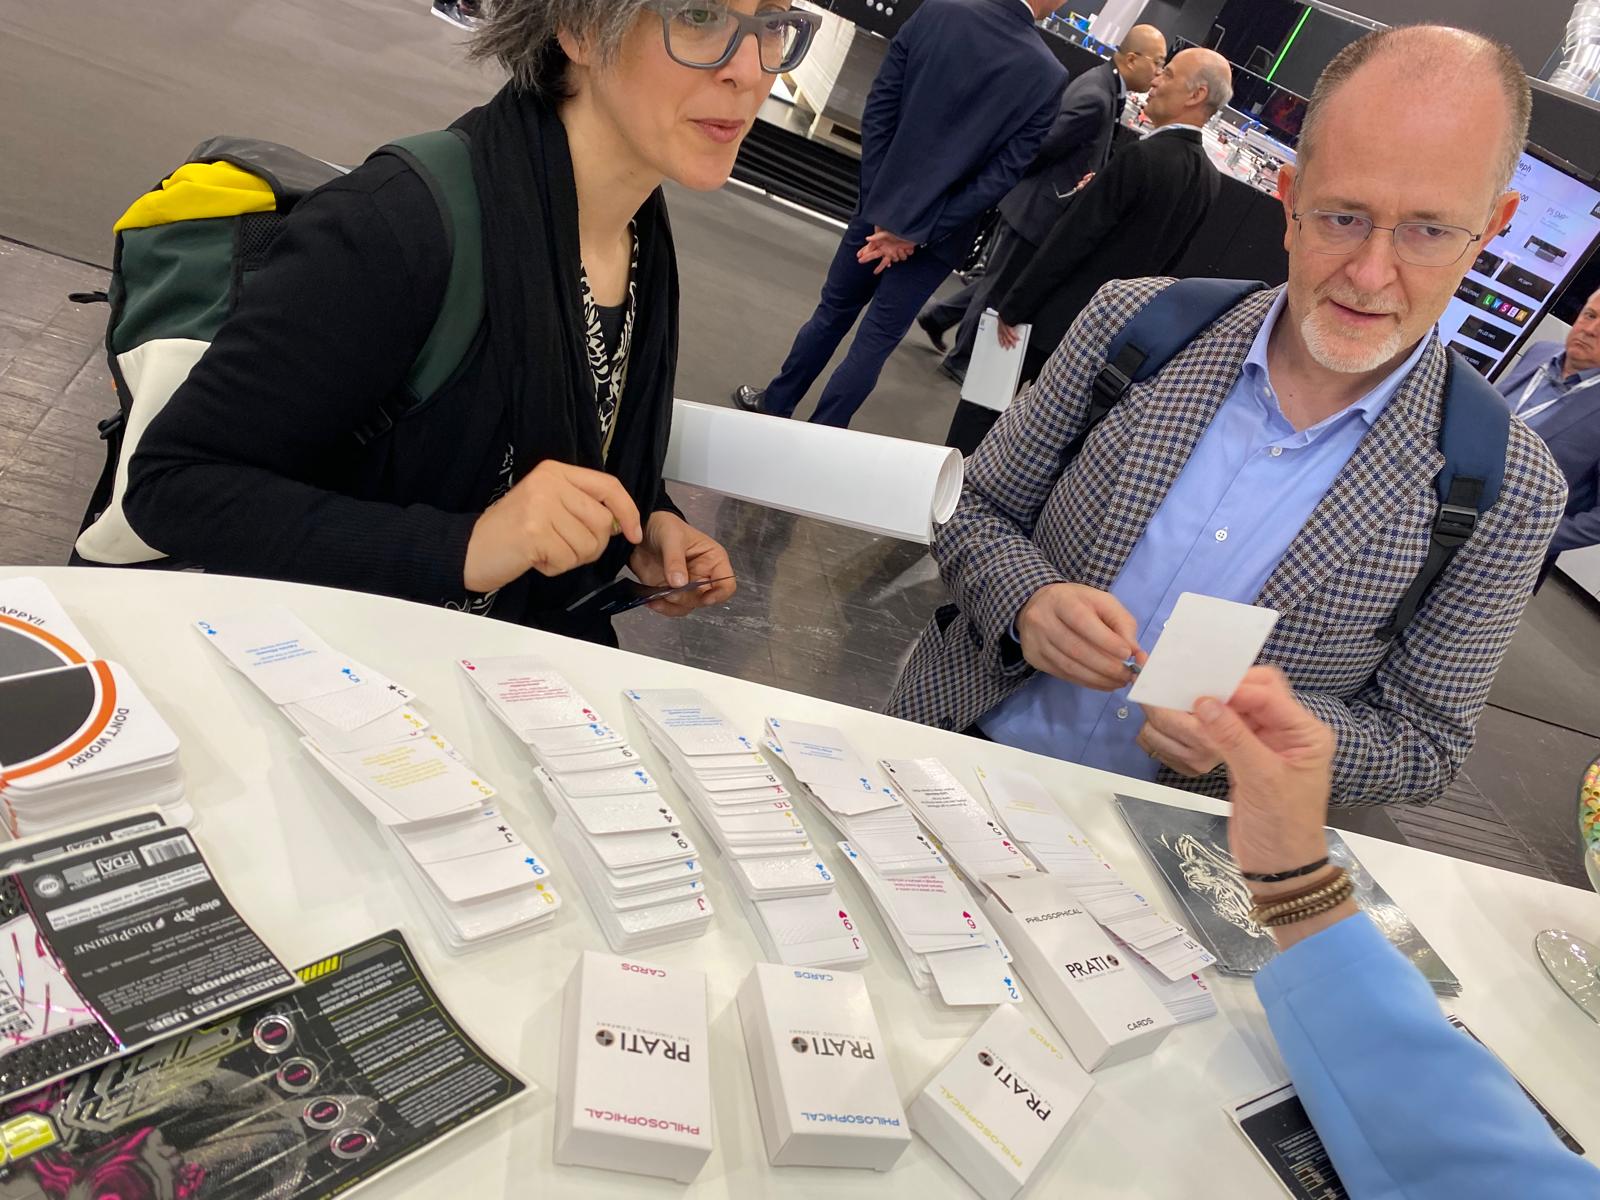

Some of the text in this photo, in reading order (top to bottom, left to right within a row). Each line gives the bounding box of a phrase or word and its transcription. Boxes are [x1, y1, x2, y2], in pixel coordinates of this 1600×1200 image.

[68, 737, 112, 770] WORRY
[101, 853, 135, 874] FDA
[1025, 908, 1083, 924] PHILOSOPHICAL
[621, 962, 667, 978] CARDS
[793, 970, 834, 982] CARDS
[1065, 956, 1110, 979] PRATI
[1127, 1017, 1154, 1031] CARDS
[620, 1032, 690, 1063] PRATI
[812, 1037, 875, 1060] PRATI
[1028, 1027, 1063, 1060] CARDS
[993, 1065, 1052, 1121] PRATI
[584, 1107, 700, 1136] PHILOSOPHICAL
[801, 1111, 900, 1127] PHILOSOPHICAL
[940, 1084, 1023, 1168] PHILOSOPHICAL
